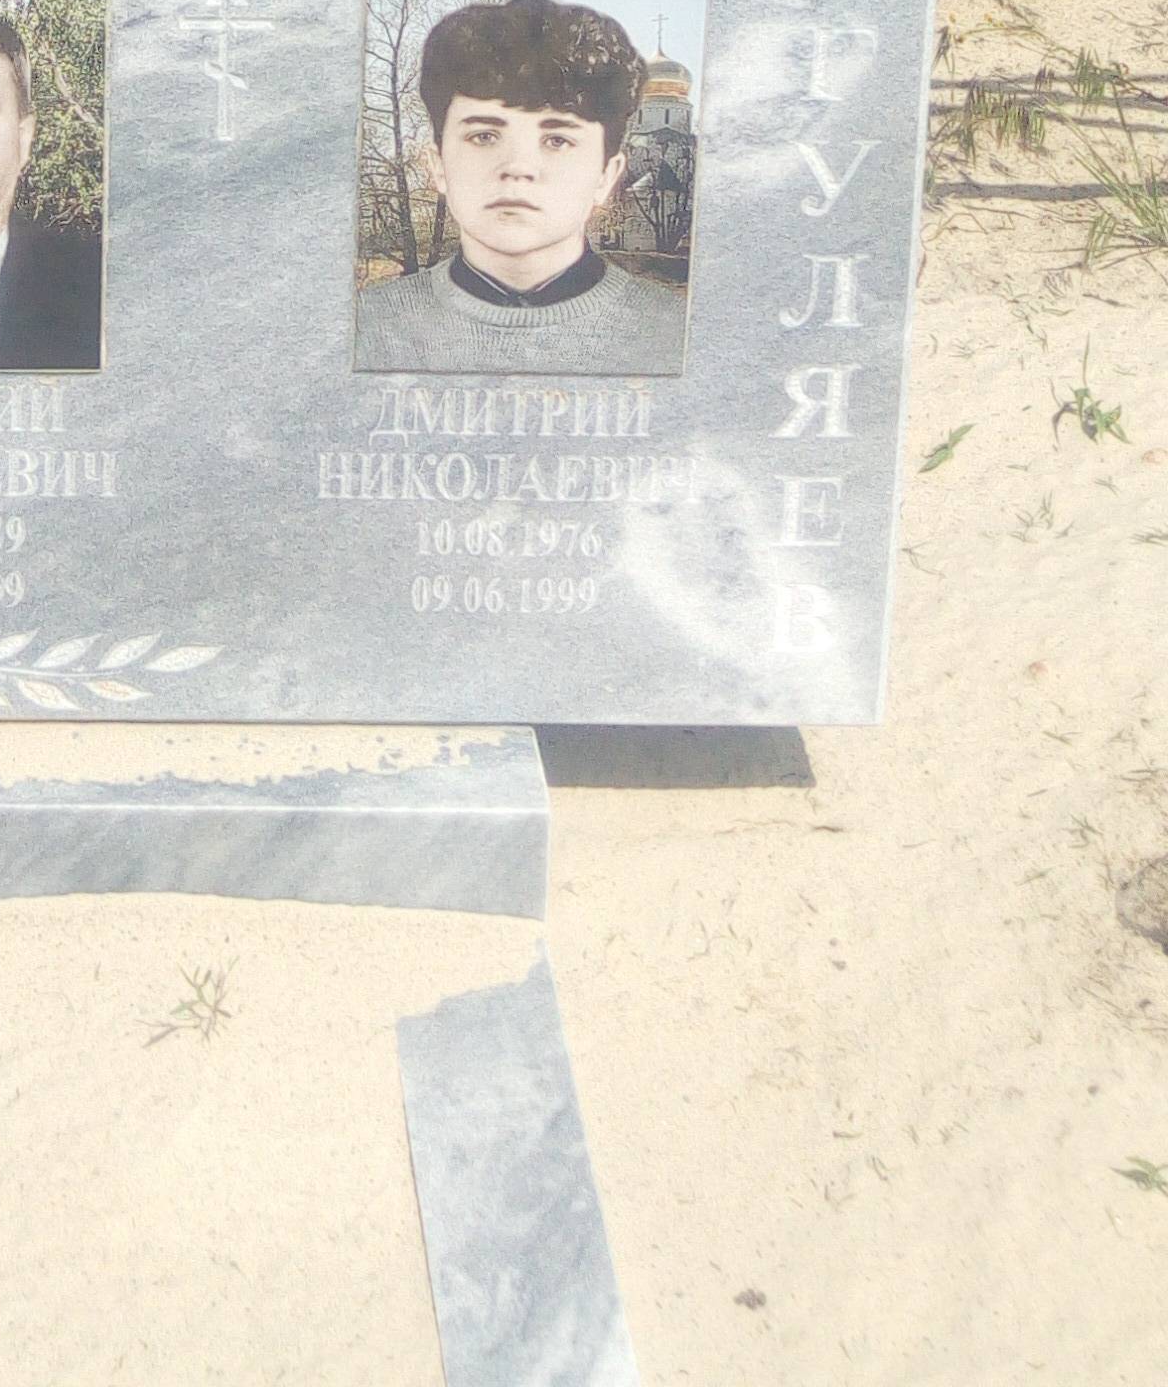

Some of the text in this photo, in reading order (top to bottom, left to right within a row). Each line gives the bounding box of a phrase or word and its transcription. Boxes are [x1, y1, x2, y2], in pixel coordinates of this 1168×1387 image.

[768, 27, 880, 653] ГУЛЯЕВ
[369, 382, 652, 448] ДМИТРИЙ
[318, 451, 703, 504] НИКОЛАЕВИЧ
[415, 518, 602, 558] 10.08.1976
[411, 575, 597, 615] 09.06.1999
